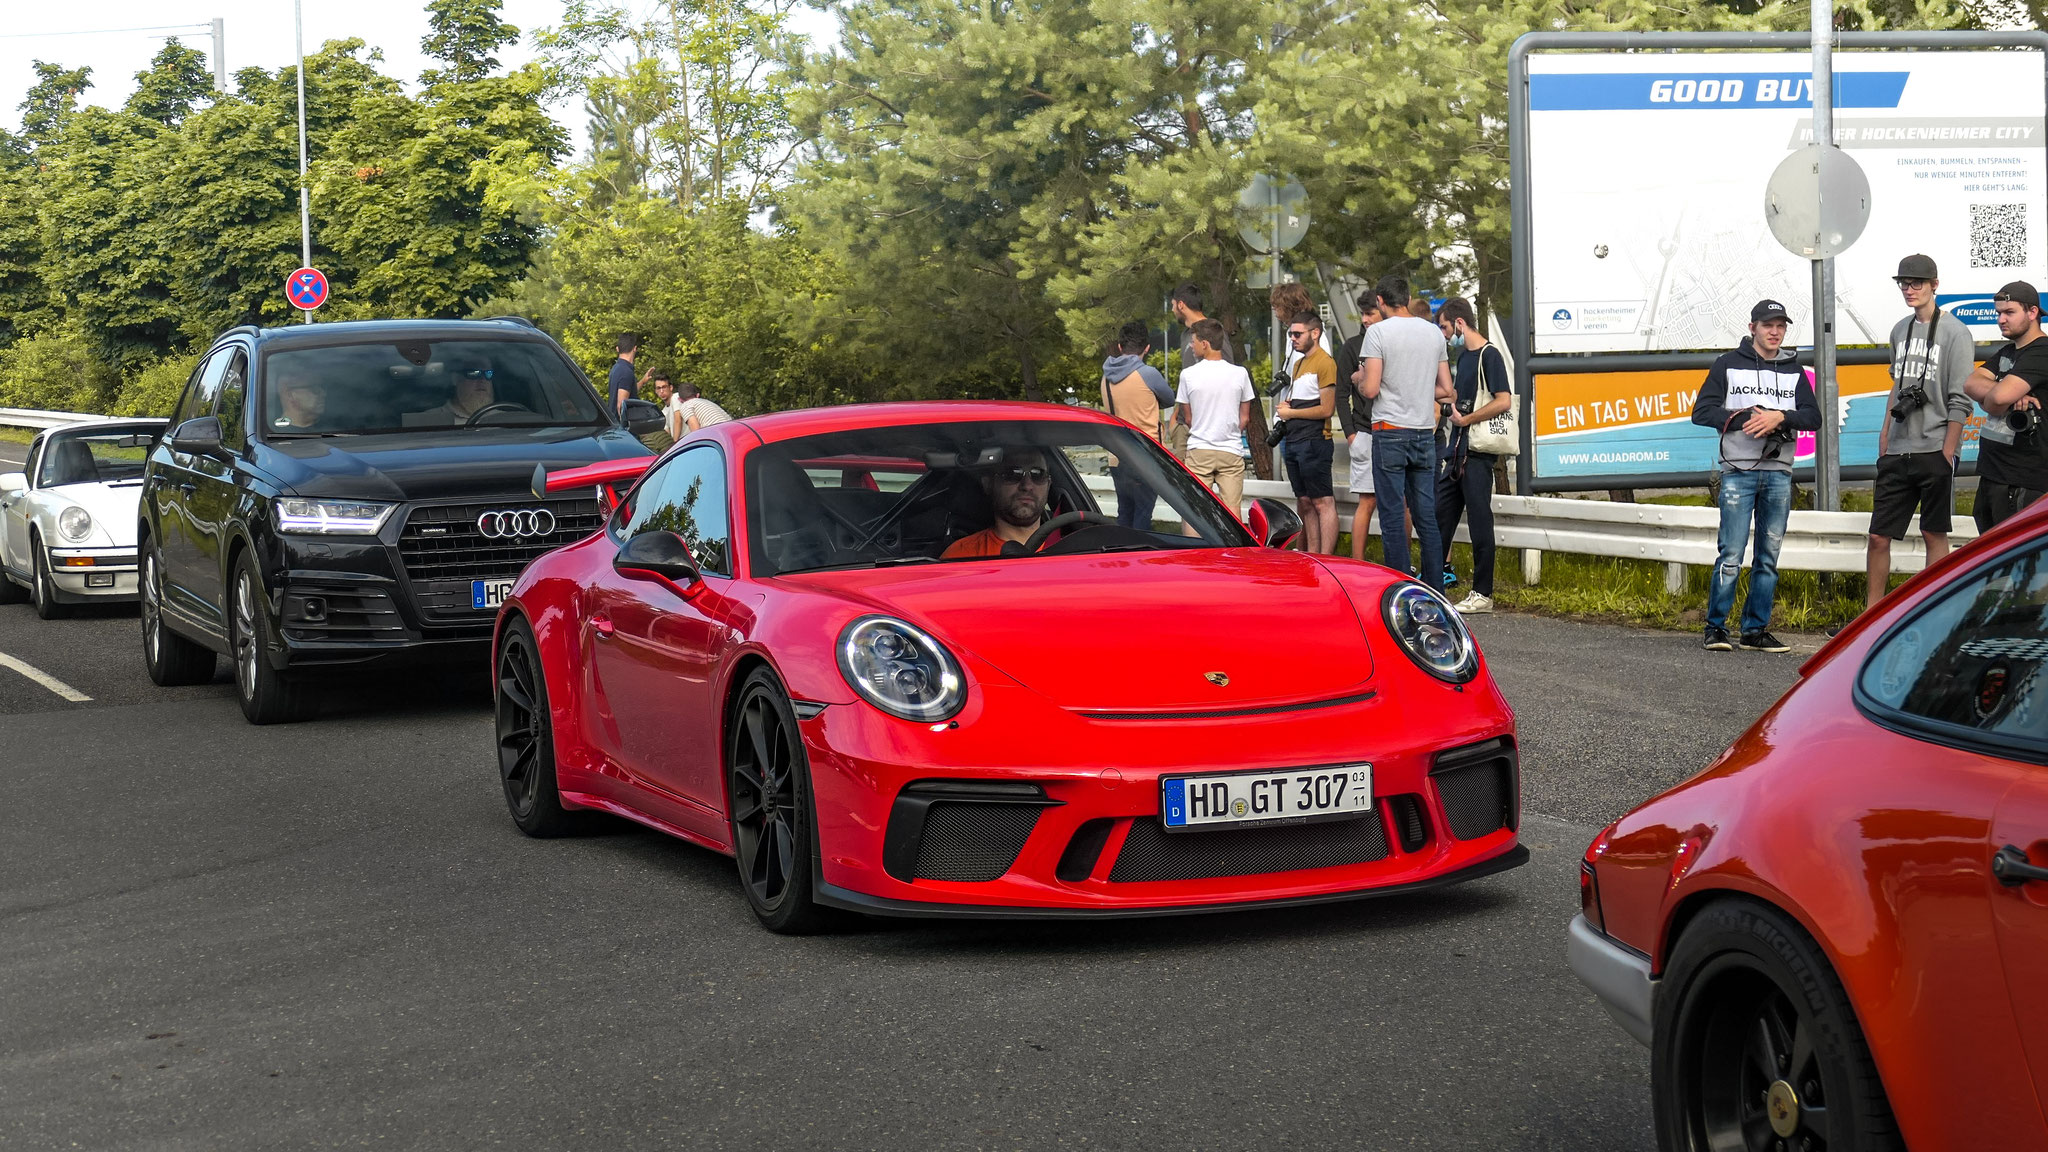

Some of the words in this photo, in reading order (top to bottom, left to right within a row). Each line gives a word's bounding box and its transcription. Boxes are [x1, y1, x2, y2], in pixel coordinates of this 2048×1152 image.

[1649, 79, 1744, 103] GOOD
[1832, 128, 1857, 140] ER
[1861, 127, 1990, 140] HOCKENHEIMER
[1995, 126, 2035, 139] CITY
[1897, 158, 1938, 166] EINKAUFEN,
[1940, 157, 1975, 165] BUMMELN,
[1977, 157, 2021, 165] ENTSPANNEN
[1914, 171, 1929, 179] NUR
[1931, 171, 1957, 179] WENIGE
[1959, 170, 1990, 178] MINUTEN
[1992, 170, 2028, 178] ENTFERNT!
[1964, 184, 1980, 192] HIER
[2007, 183, 2028, 191] LANG:
[1583, 307, 1636, 315] hockenheimer
[1956, 308, 1999, 316] HOCKENH
[1894, 361, 1938, 381] CLLEGE
[1554, 404, 1585, 429] EIN
[1590, 399, 1629, 424] TAG
[1634, 393, 1671, 418] WIE
[1676, 389, 1698, 413] IM
[1489, 420, 1505, 428] MIS
[1490, 427, 1508, 435] SION
[1558, 451, 1670, 465] WWW.AQUADROM.DE
[1353, 771, 1365, 782] 03
[1190, 782, 1229, 818] HD
[1251, 778, 1288, 814] GT
[1296, 773, 1348, 811] 307
[1353, 795, 1366, 807] 11
[1171, 807, 1180, 818] D
